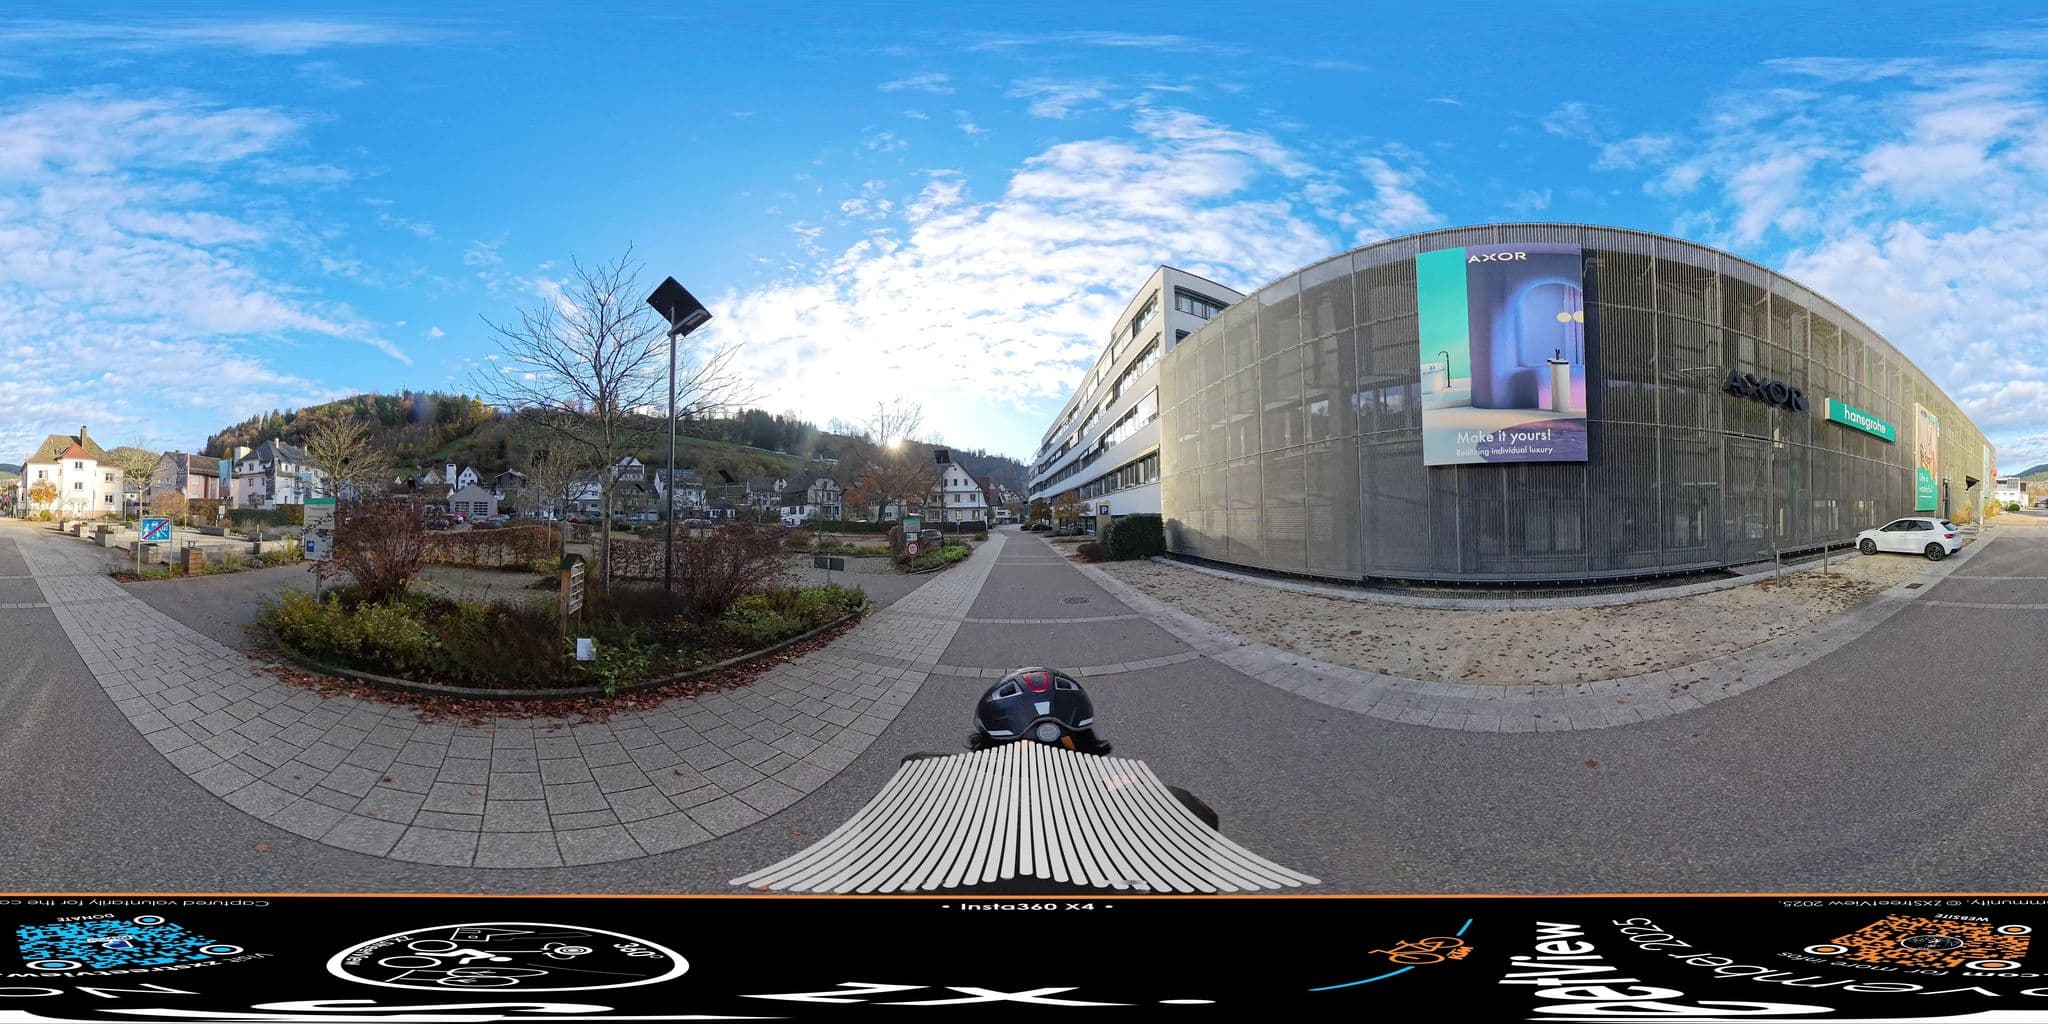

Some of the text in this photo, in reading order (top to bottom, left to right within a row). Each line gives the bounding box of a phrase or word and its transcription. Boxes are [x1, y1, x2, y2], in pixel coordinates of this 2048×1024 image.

[1468, 251, 1528, 264] AXOR
[1721, 368, 1810, 413] AXOR
[1844, 404, 1887, 434] hansgrohe
[1456, 428, 1552, 445] Make it yours!
[1491, 446, 1528, 455] individual
[1529, 446, 1554, 455] luxury
